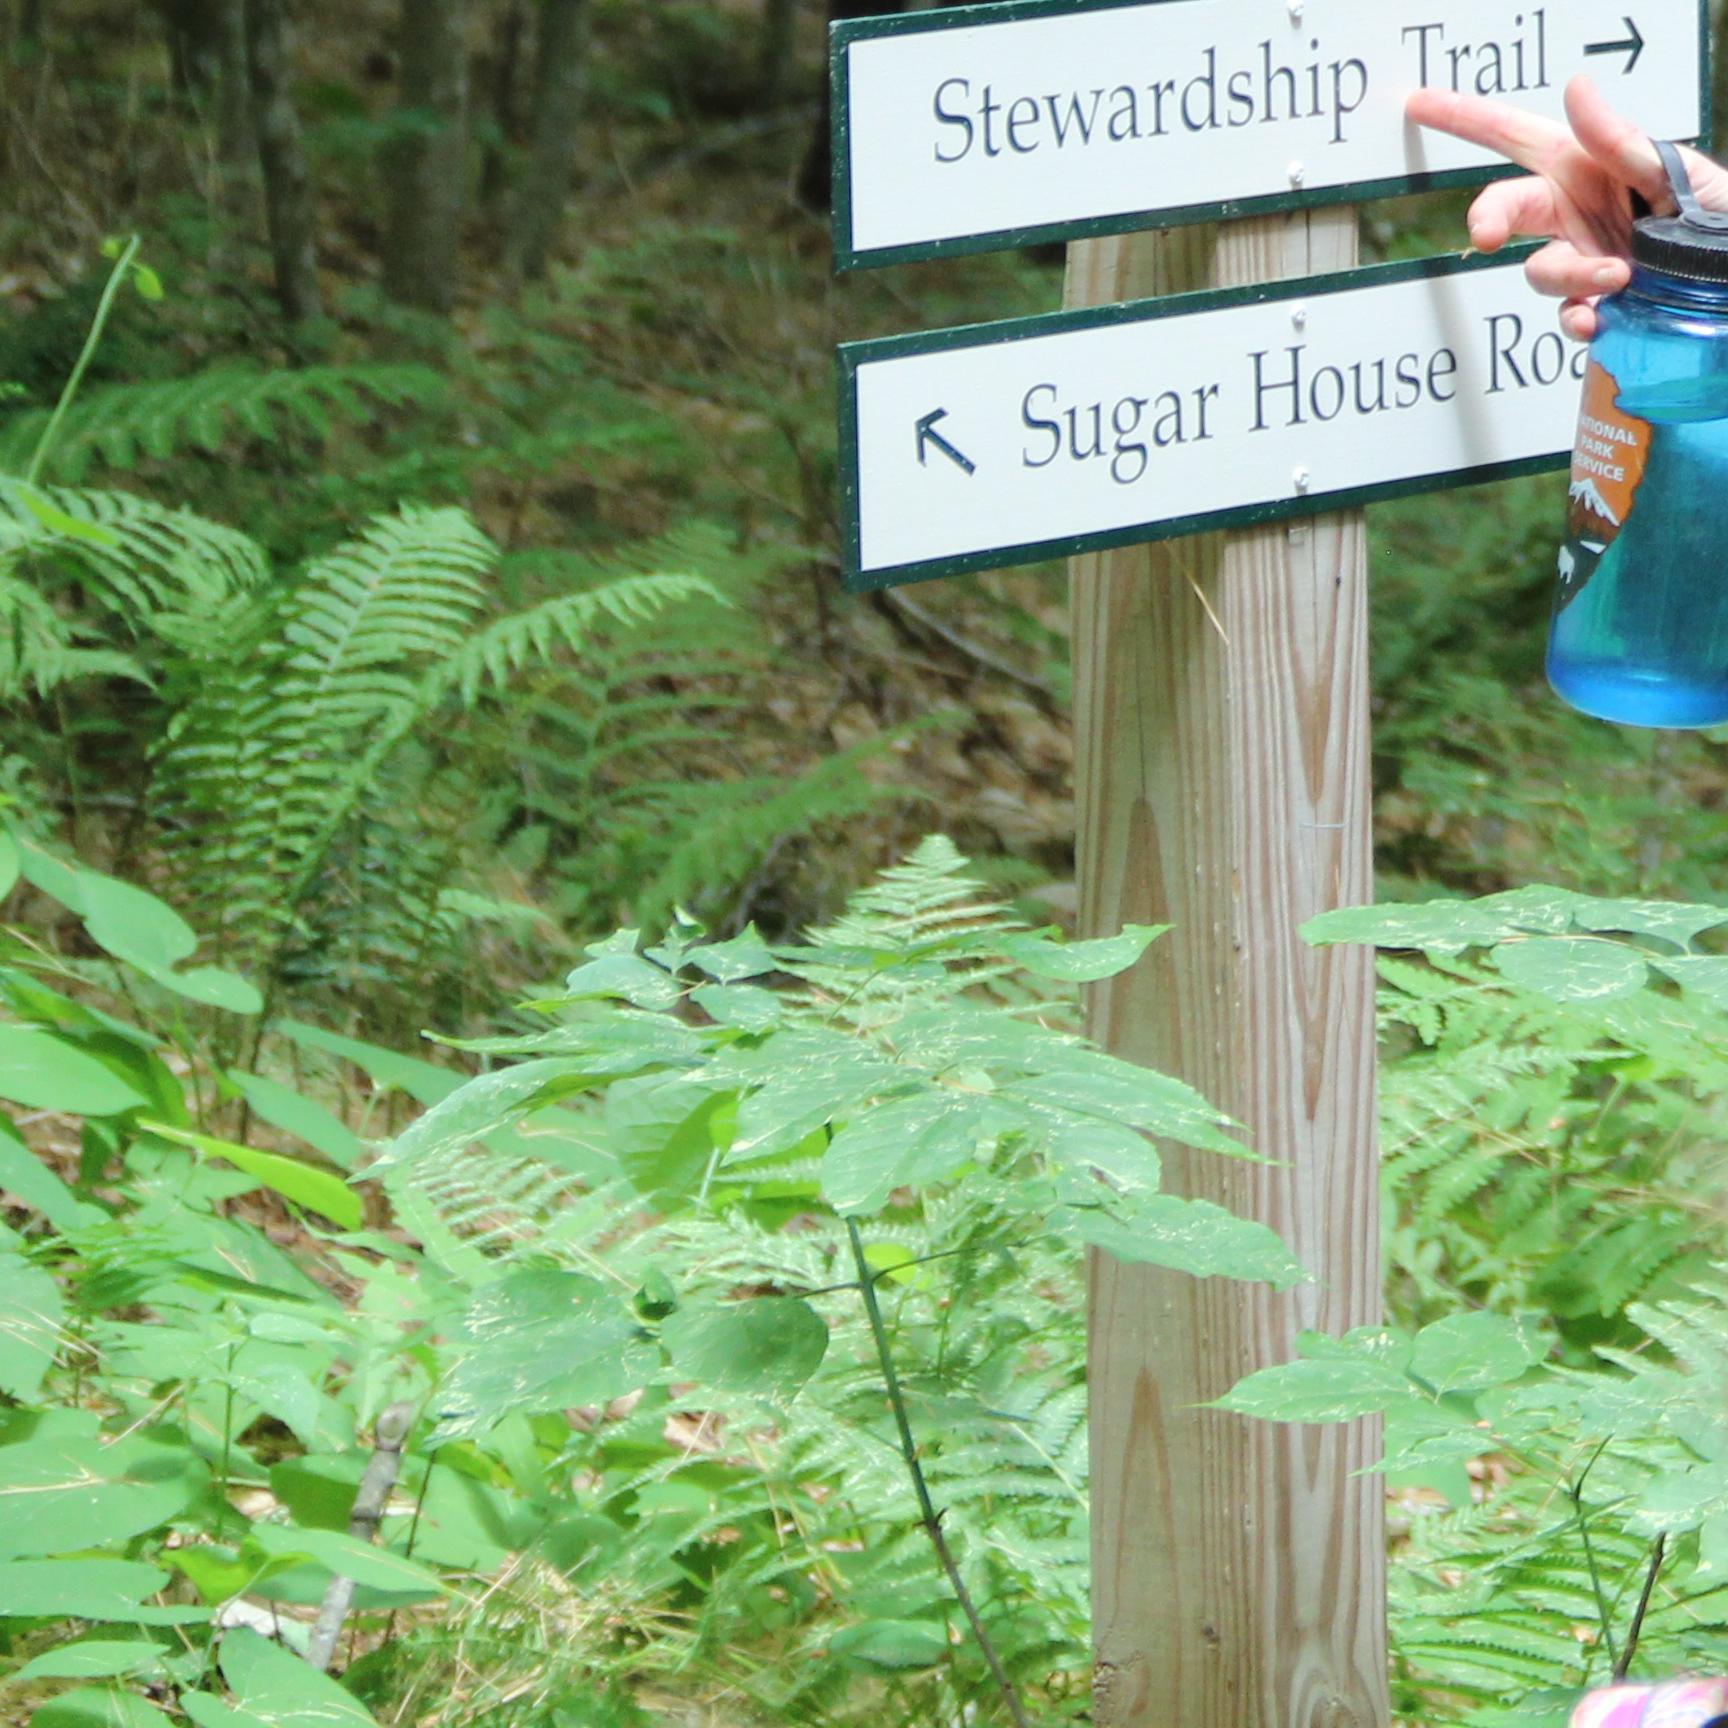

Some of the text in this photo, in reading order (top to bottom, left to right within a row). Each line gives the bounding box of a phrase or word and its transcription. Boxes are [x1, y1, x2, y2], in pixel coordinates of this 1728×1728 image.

[932, 7, 1551, 164] Stewardship Trail
[1021, 312, 1590, 485] Sugar House Ro
